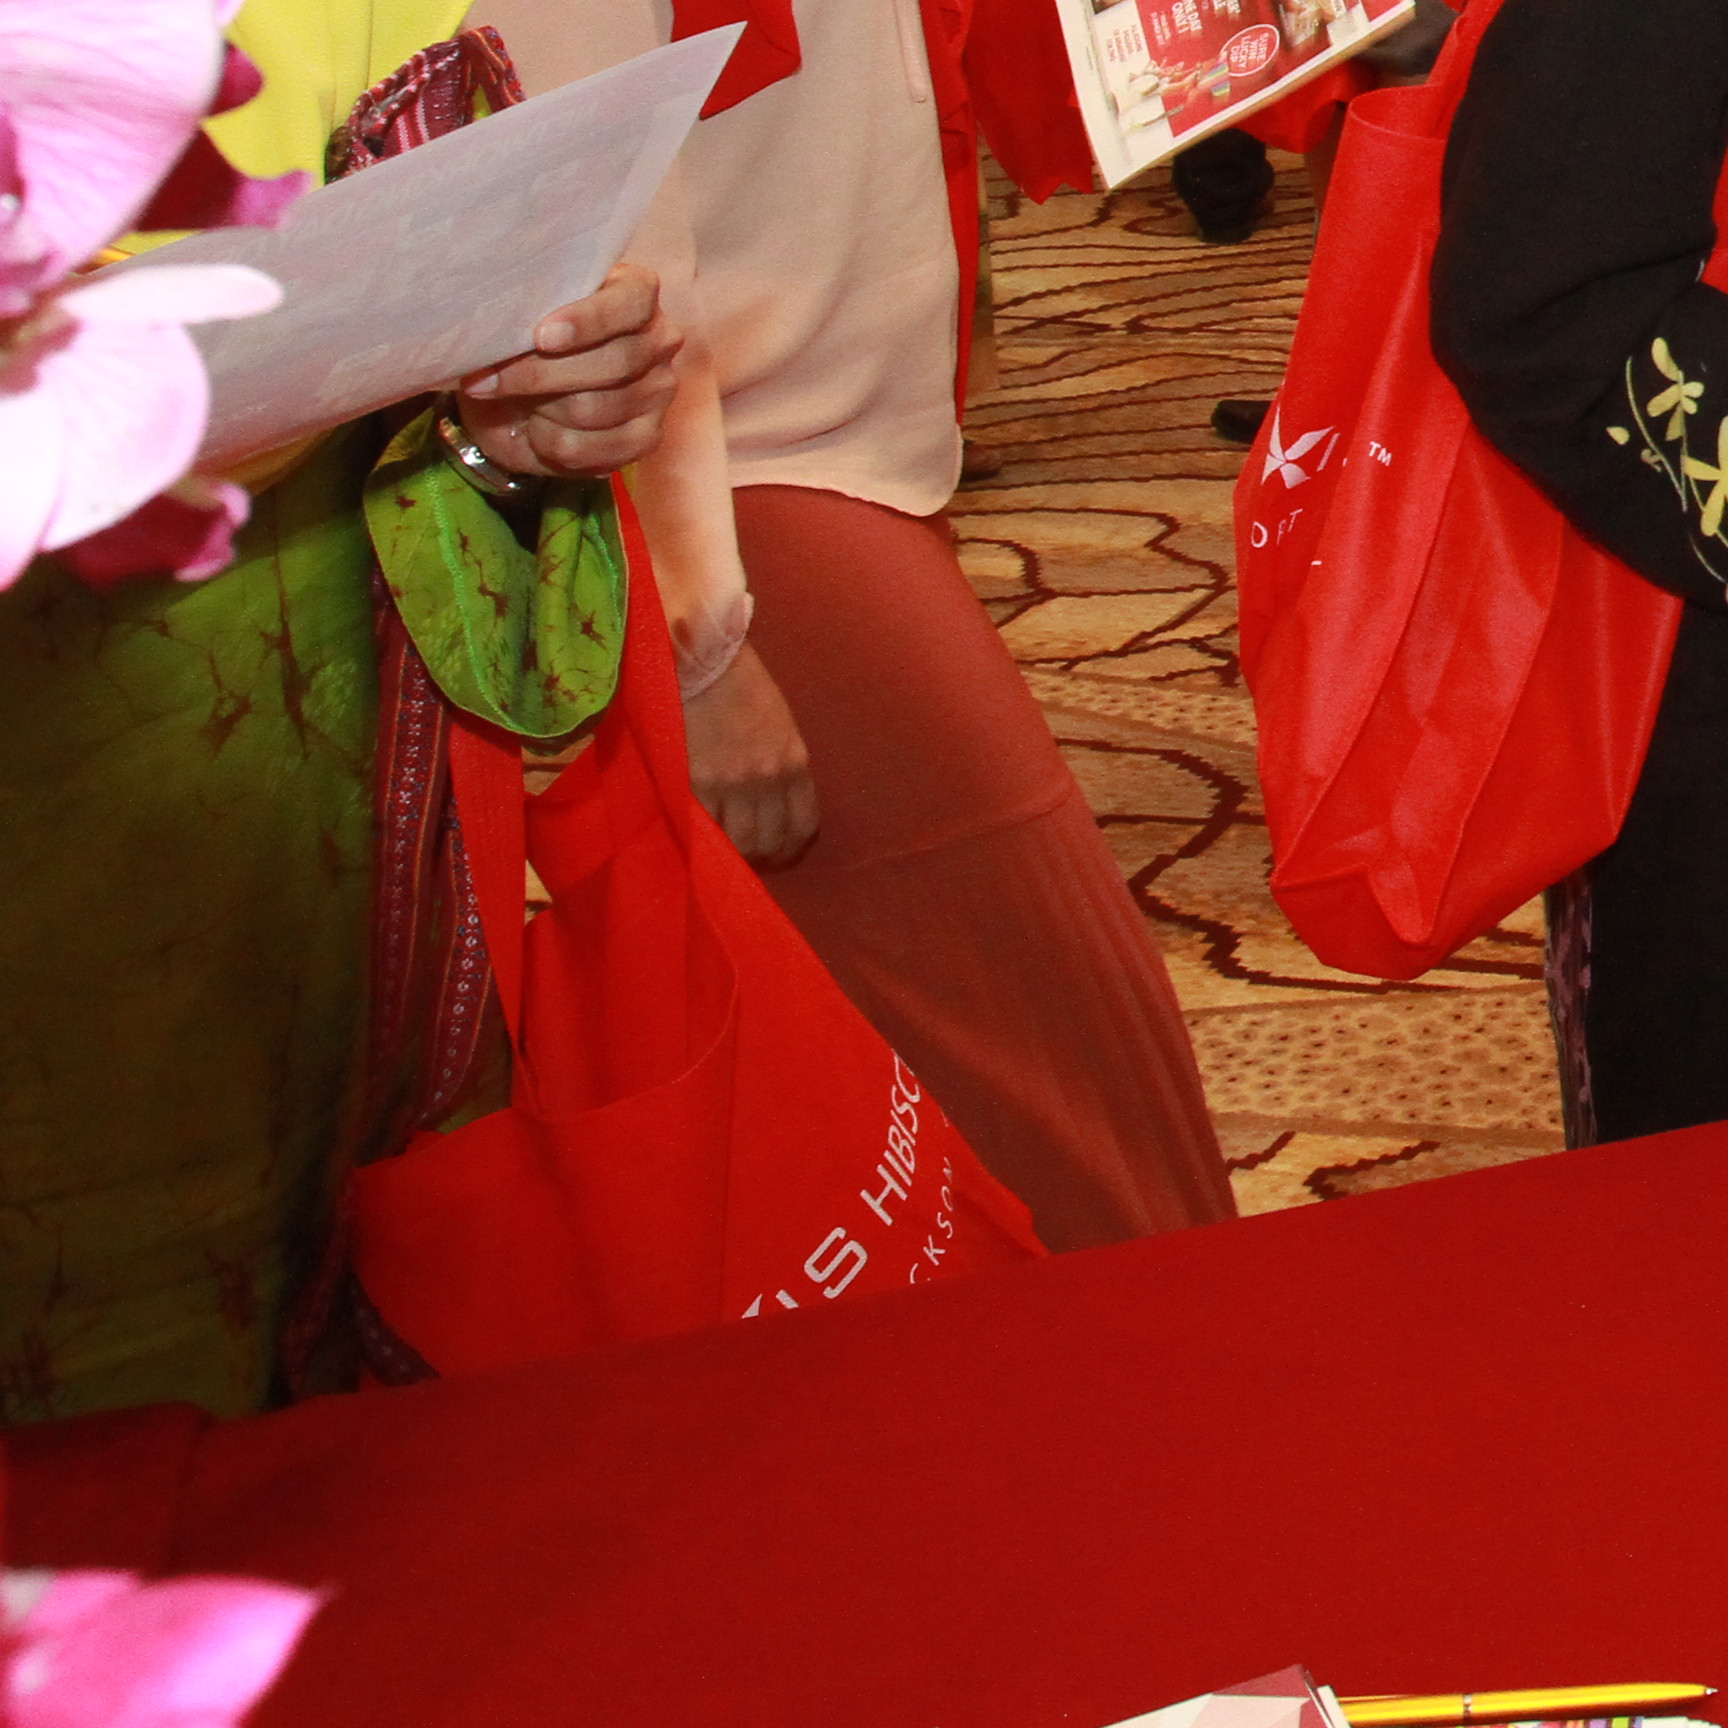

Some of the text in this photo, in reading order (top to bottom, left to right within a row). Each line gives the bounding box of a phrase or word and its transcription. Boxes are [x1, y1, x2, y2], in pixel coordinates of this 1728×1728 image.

[1171, 2, 1187, 27] ONLY
[1187, 11, 1203, 31] DAY
[1231, 44, 1239, 63] DIP
[1238, 35, 1250, 68] LUCKY
[1248, 39, 1258, 60] WIN
[1258, 32, 1267, 61] SURE
